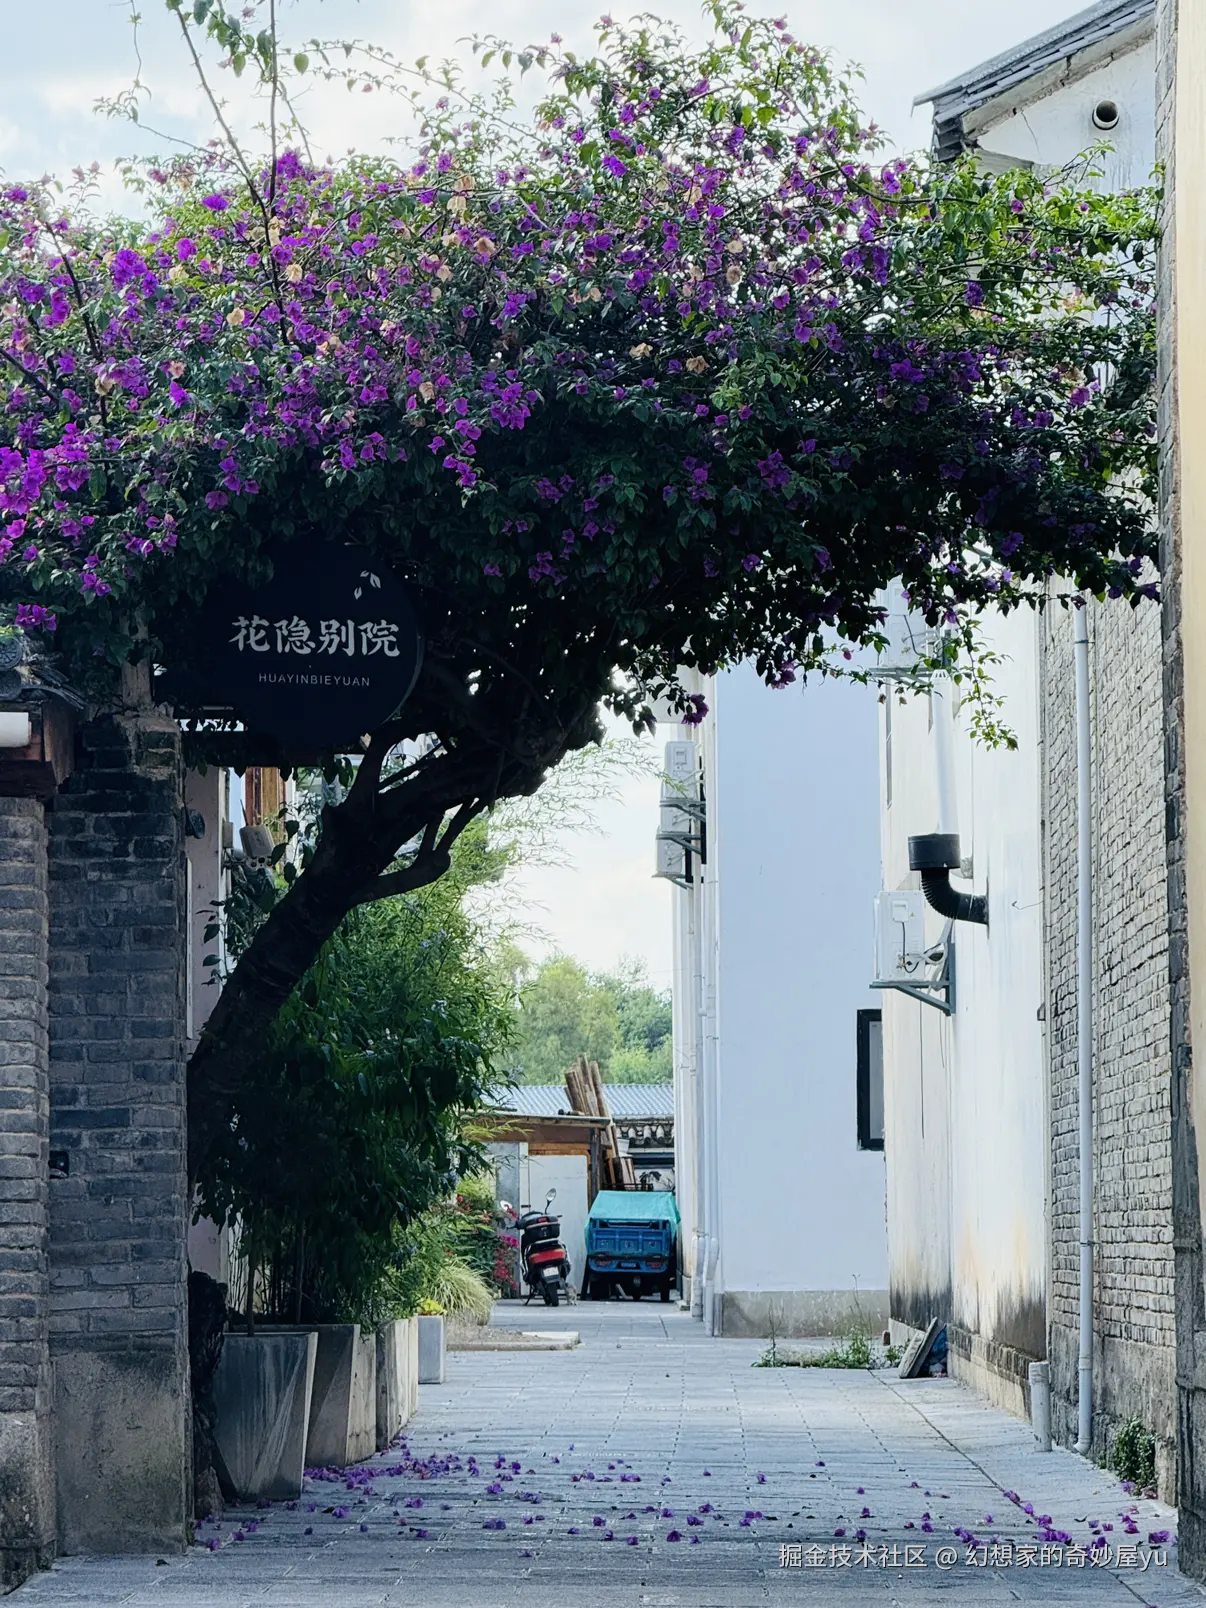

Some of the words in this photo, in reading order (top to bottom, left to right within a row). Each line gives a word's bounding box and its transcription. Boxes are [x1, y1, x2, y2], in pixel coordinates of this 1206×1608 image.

[229, 615, 401, 657] 花隐别院
[258, 673, 370, 687] HUAYINBIEYUAN
